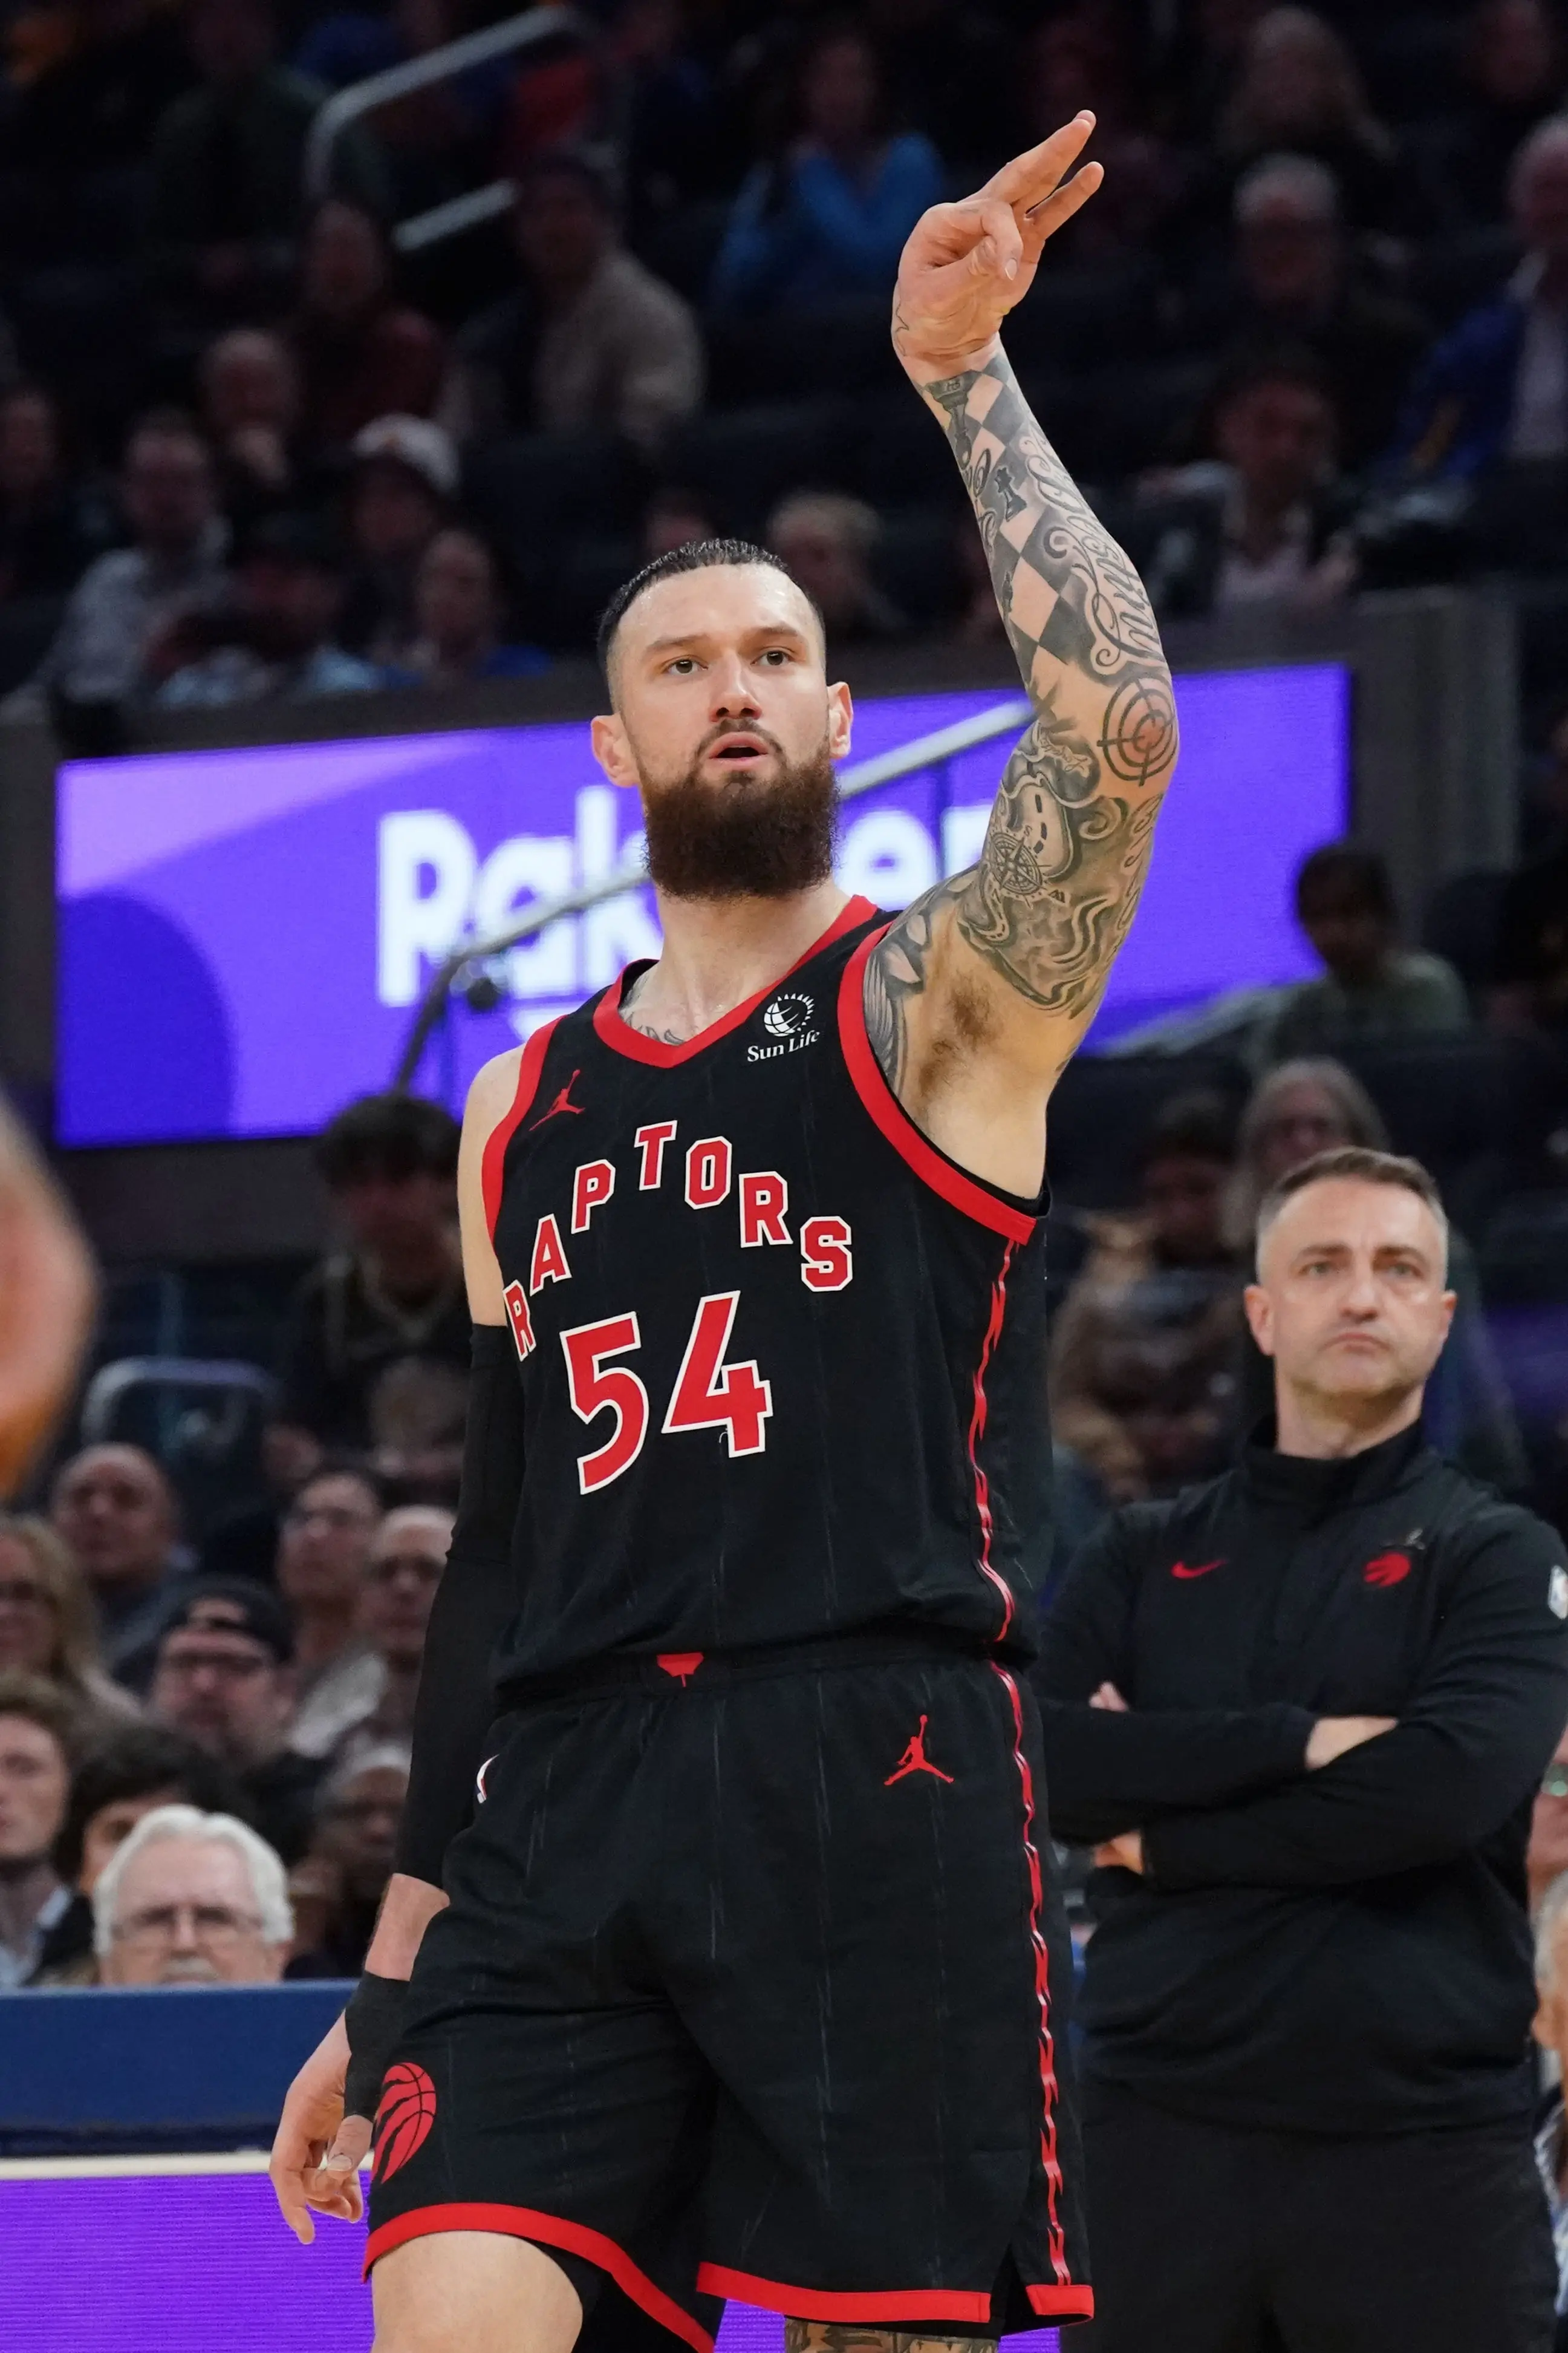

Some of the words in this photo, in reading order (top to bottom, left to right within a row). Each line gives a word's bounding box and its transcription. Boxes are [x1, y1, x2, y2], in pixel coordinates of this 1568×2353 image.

[377, 785, 994, 1008] Rake
[747, 1045, 784, 1062] Sun
[788, 1030, 820, 1052] Life
[503, 1120, 853, 1361] RAPTORS
[559, 1290, 773, 1494] 54
